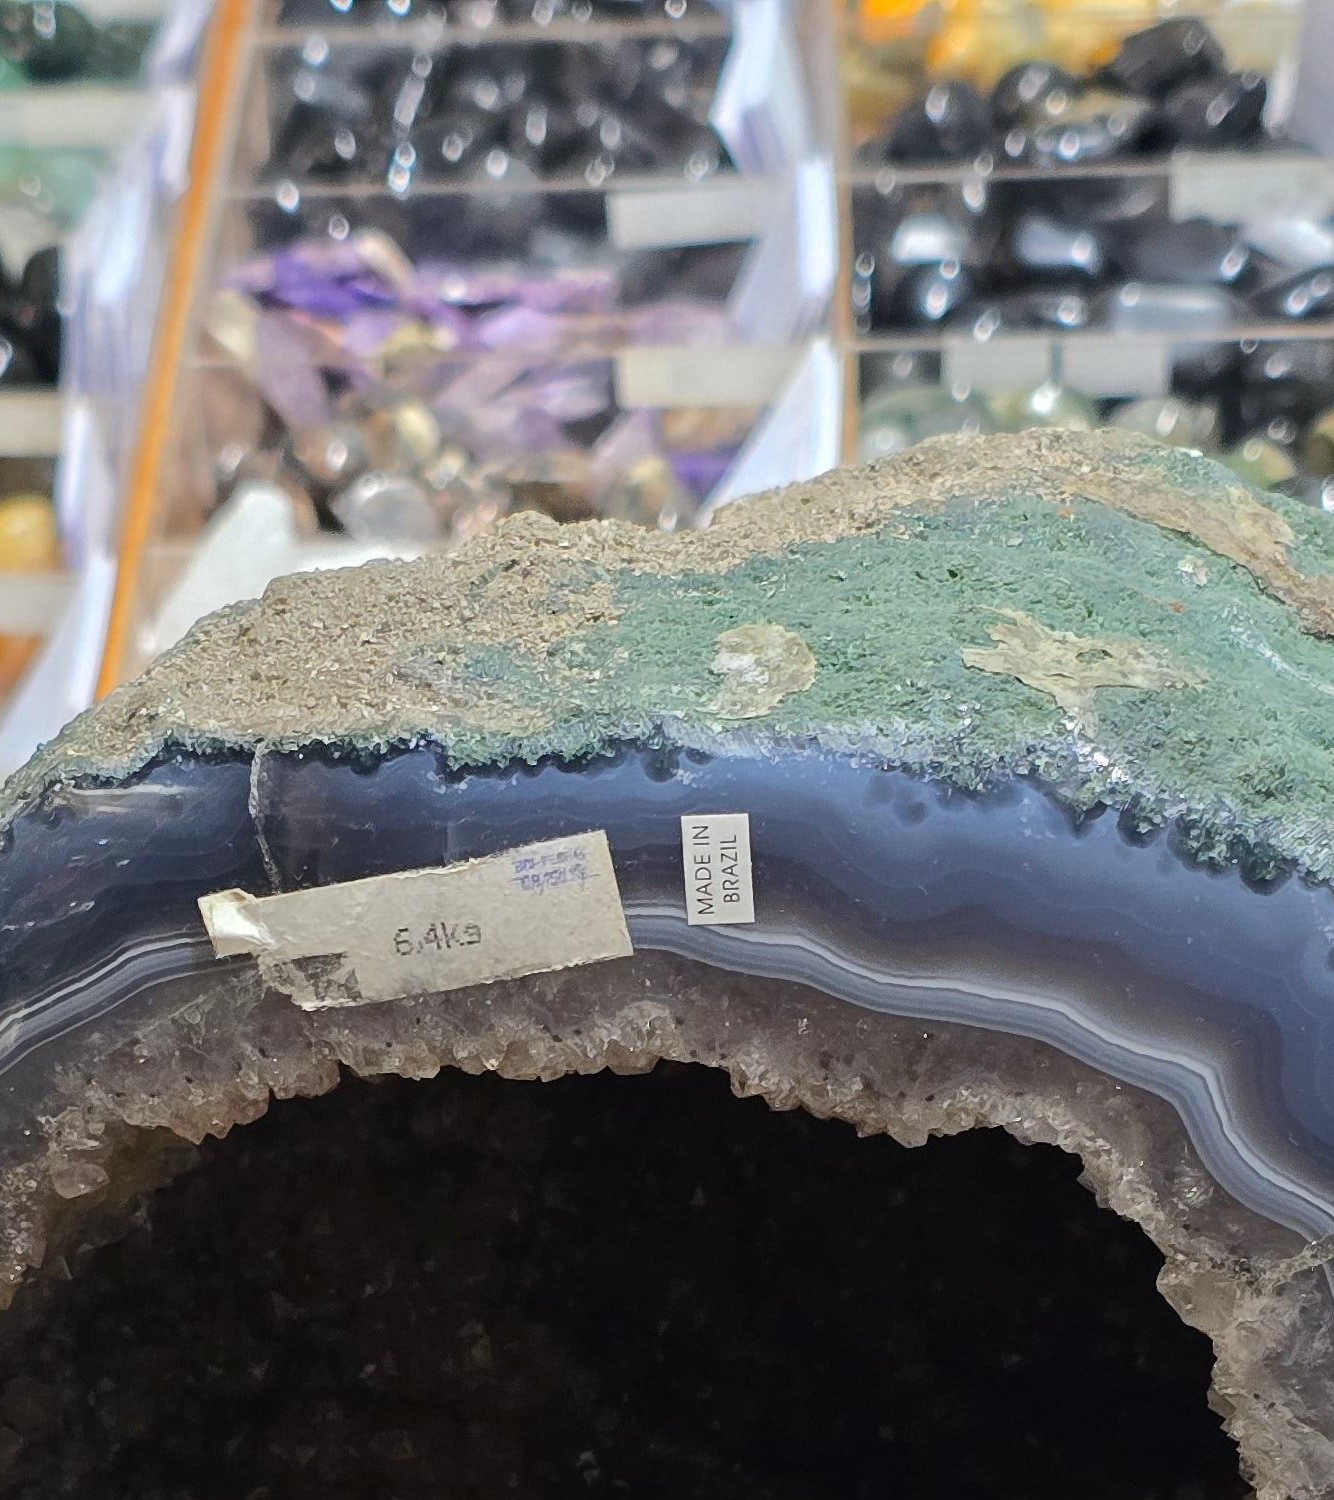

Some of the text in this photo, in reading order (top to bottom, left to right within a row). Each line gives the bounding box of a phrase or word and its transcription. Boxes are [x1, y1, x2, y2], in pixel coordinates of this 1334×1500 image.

[691, 825, 716, 915] MADE IN
[720, 834, 740, 903] BRAZIL
